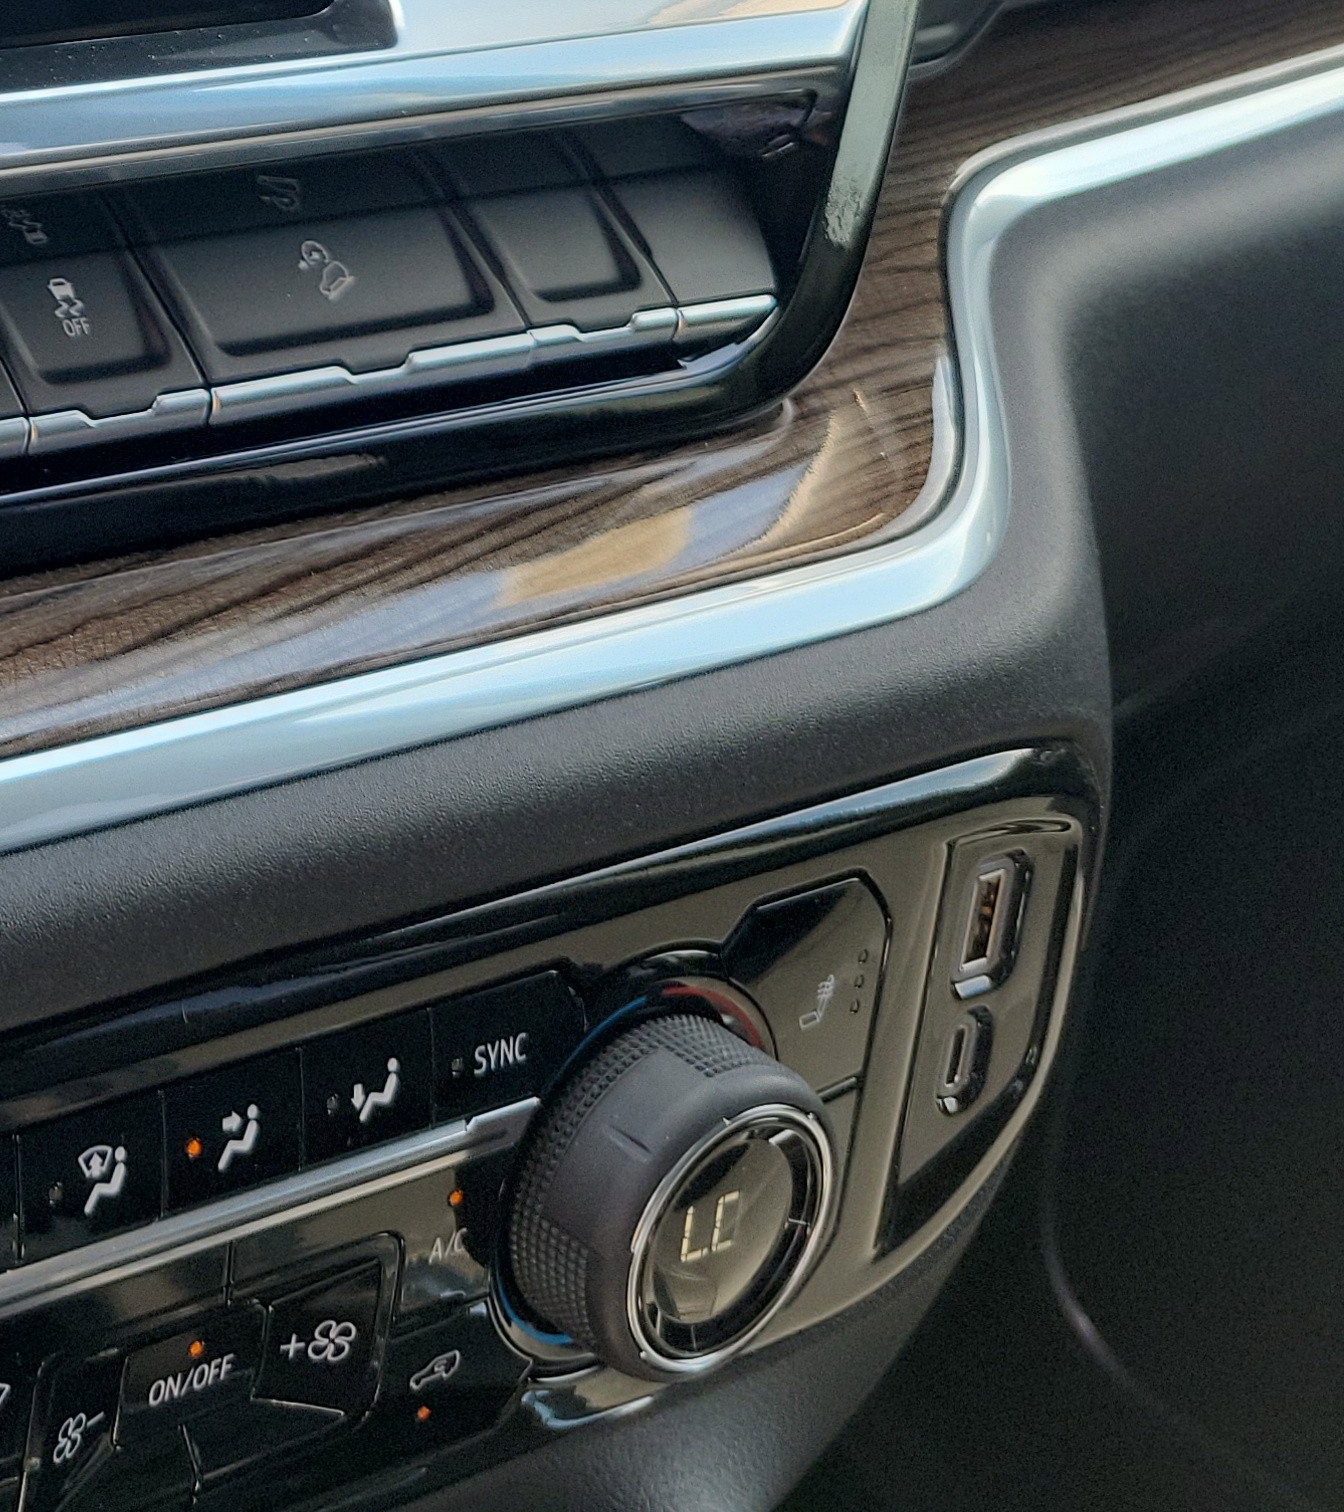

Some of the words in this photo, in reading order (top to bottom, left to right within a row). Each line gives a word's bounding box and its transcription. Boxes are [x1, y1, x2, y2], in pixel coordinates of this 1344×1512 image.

[62, 317, 89, 336] OFF
[473, 1032, 528, 1076] SYNC
[428, 1227, 468, 1265] A/C
[148, 1353, 234, 1407] ON/OFF
